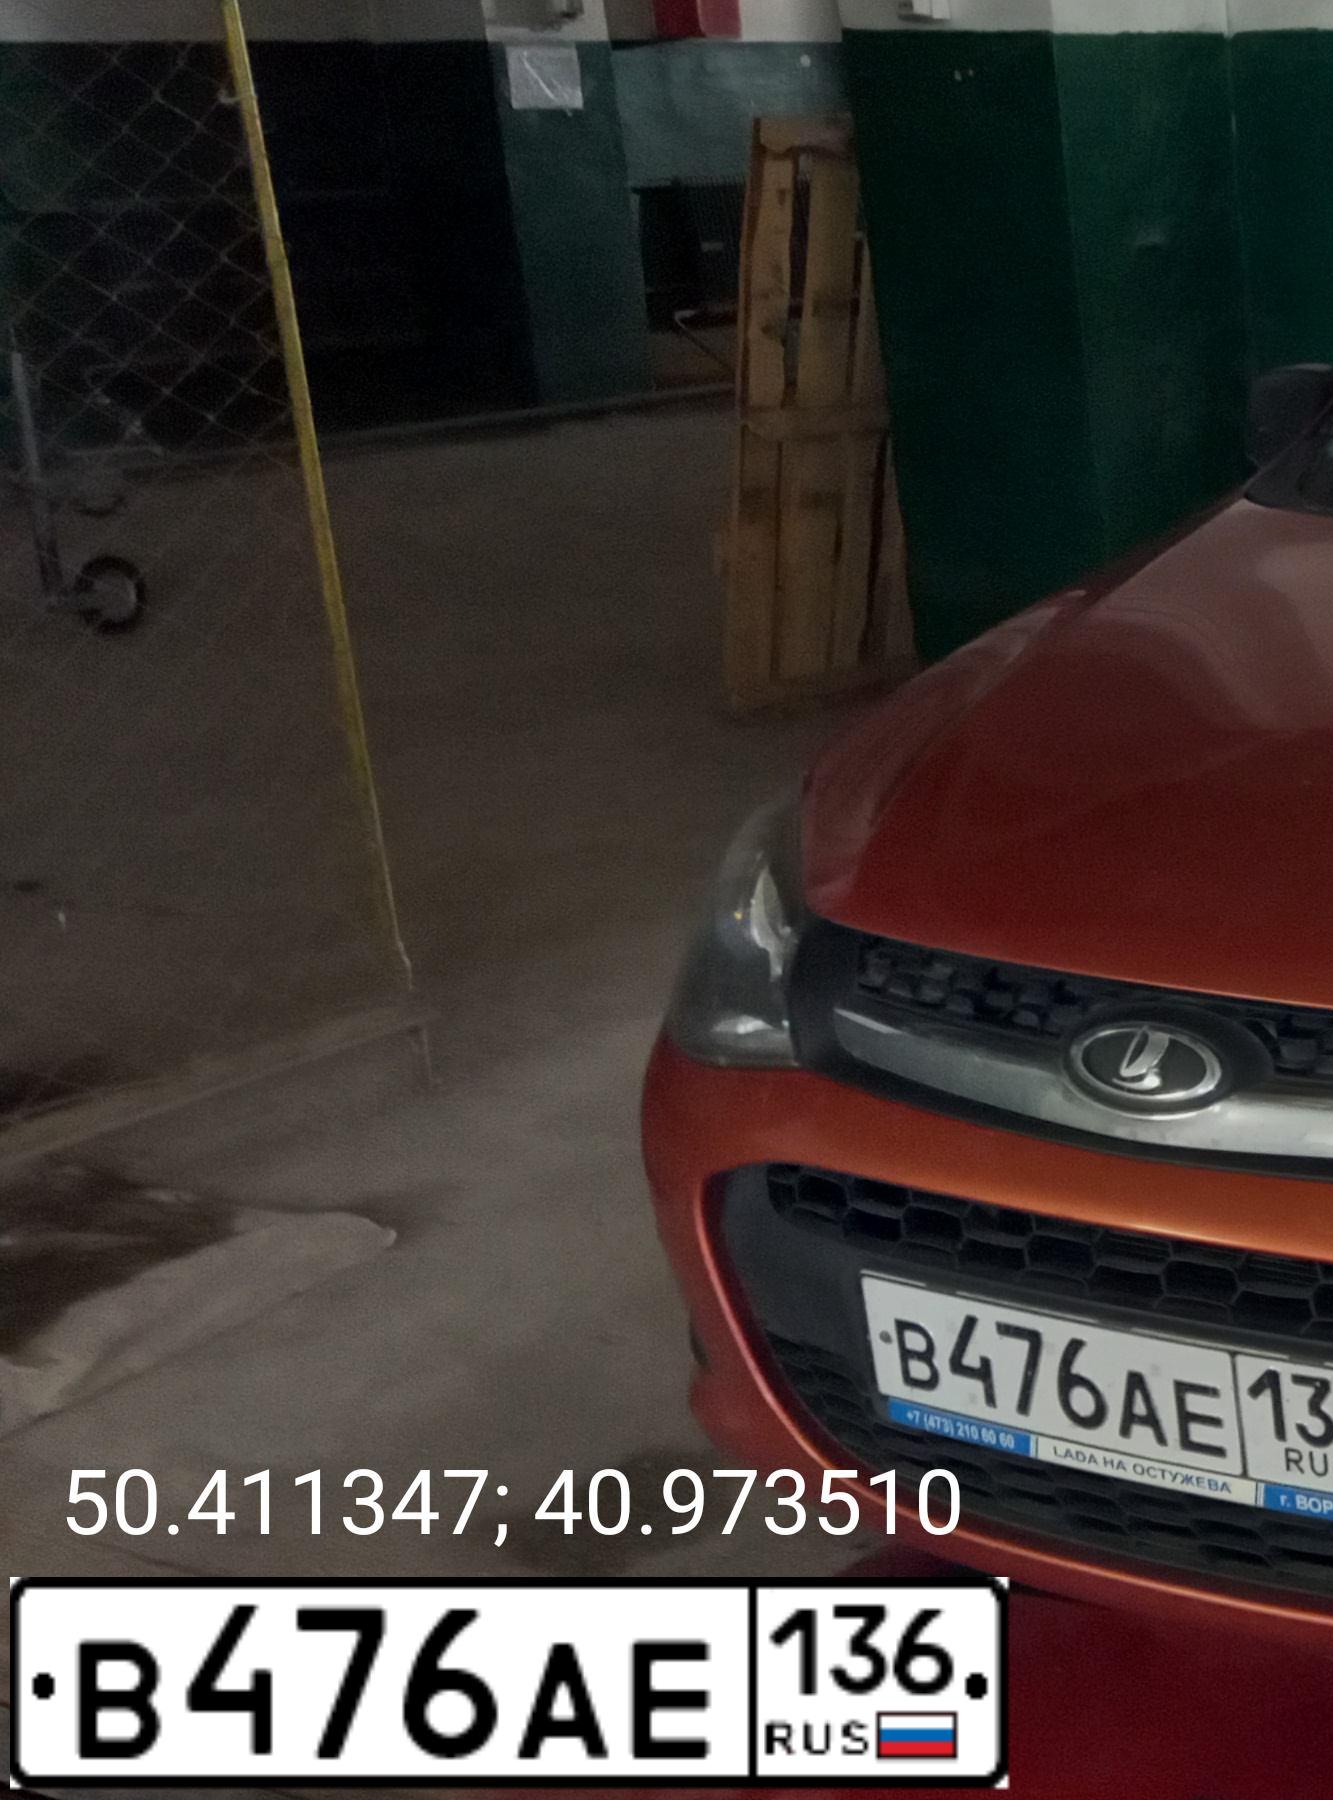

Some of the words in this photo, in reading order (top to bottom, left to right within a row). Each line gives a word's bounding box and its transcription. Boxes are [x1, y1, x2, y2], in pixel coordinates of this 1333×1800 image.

[894, 1314, 1227, 1459] В476АЕ
[906, 1410, 920, 1423] +7
[955, 1422, 979, 1442] 210
[1052, 1445, 1099, 1466] LADA
[1102, 1456, 1128, 1473] НА
[1132, 1462, 1232, 1495] ОСТУЖЕВА
[1279, 1494, 1292, 1509] г.
